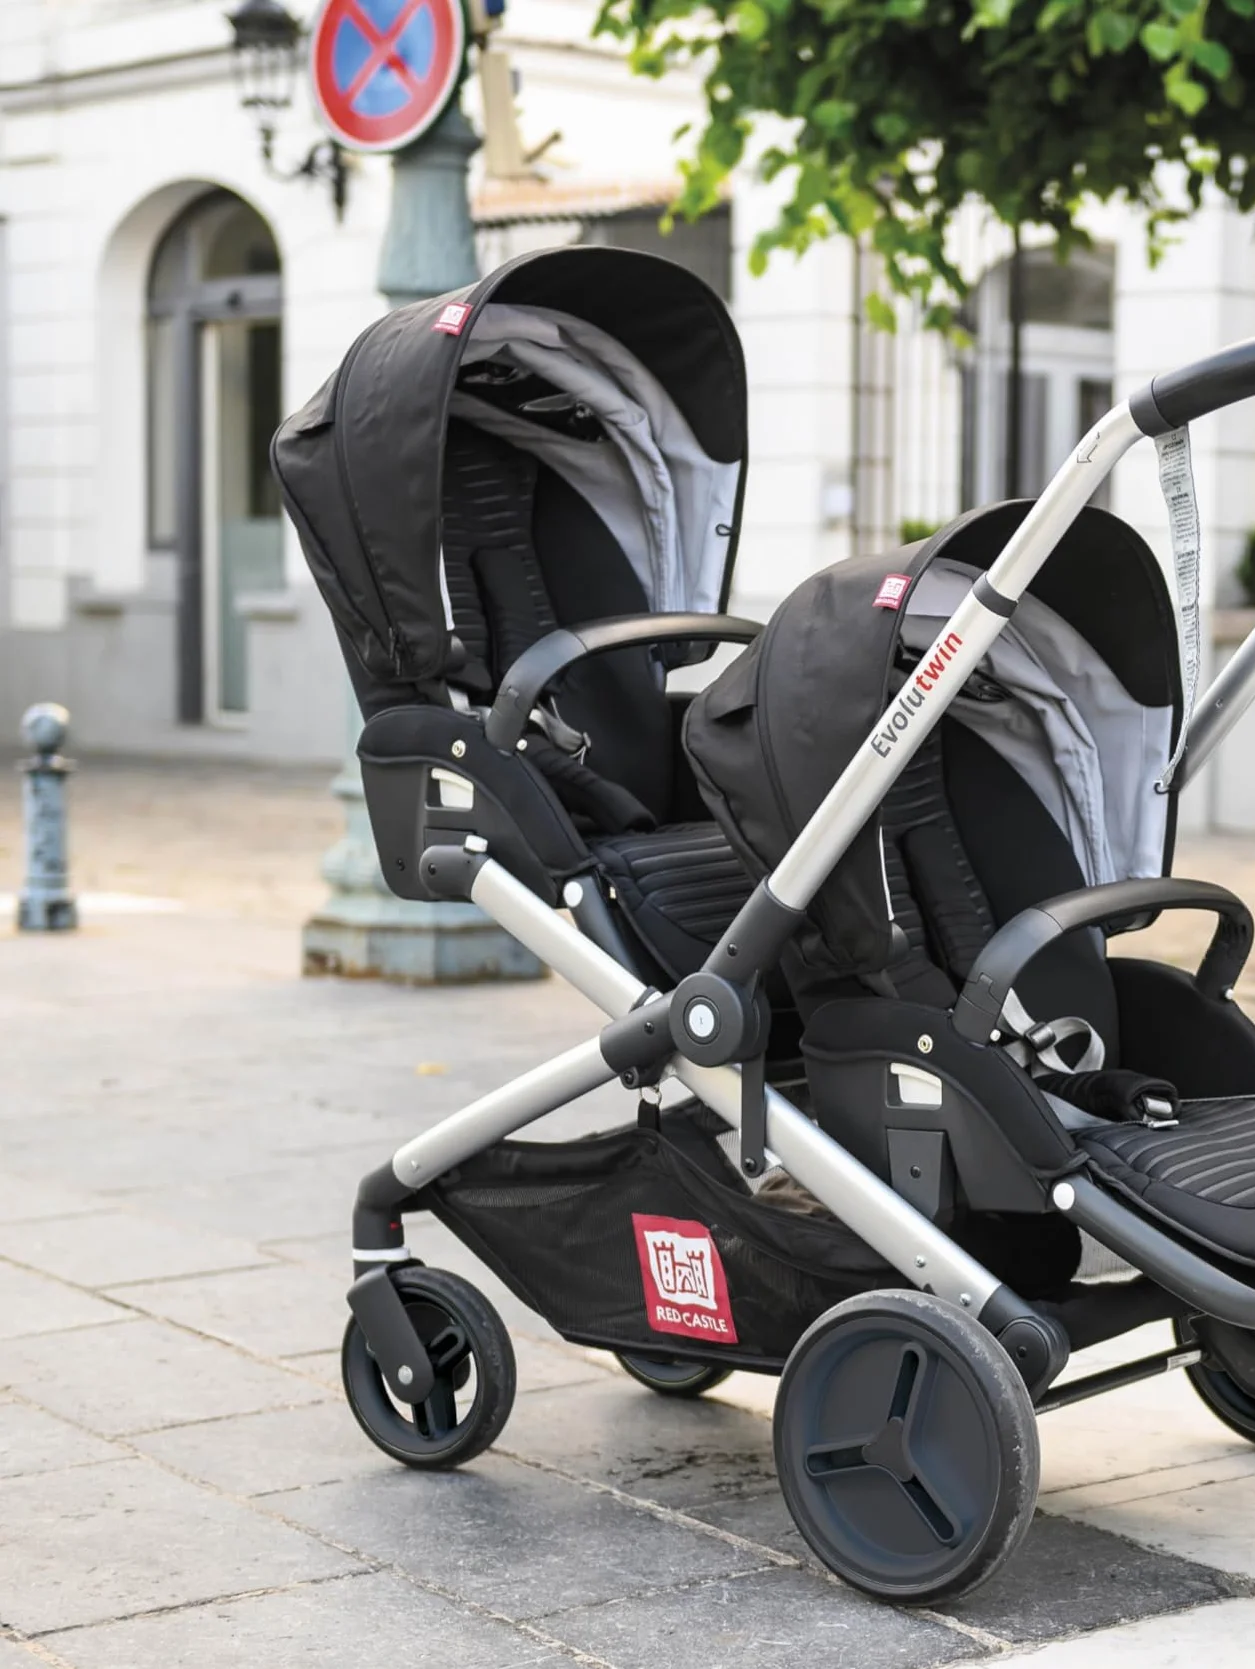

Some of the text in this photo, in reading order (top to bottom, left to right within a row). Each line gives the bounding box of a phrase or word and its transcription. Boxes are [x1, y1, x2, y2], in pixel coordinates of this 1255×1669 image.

[870, 632, 963, 758] Evolutwin
[656, 1305, 728, 1333] RED CASTLE
